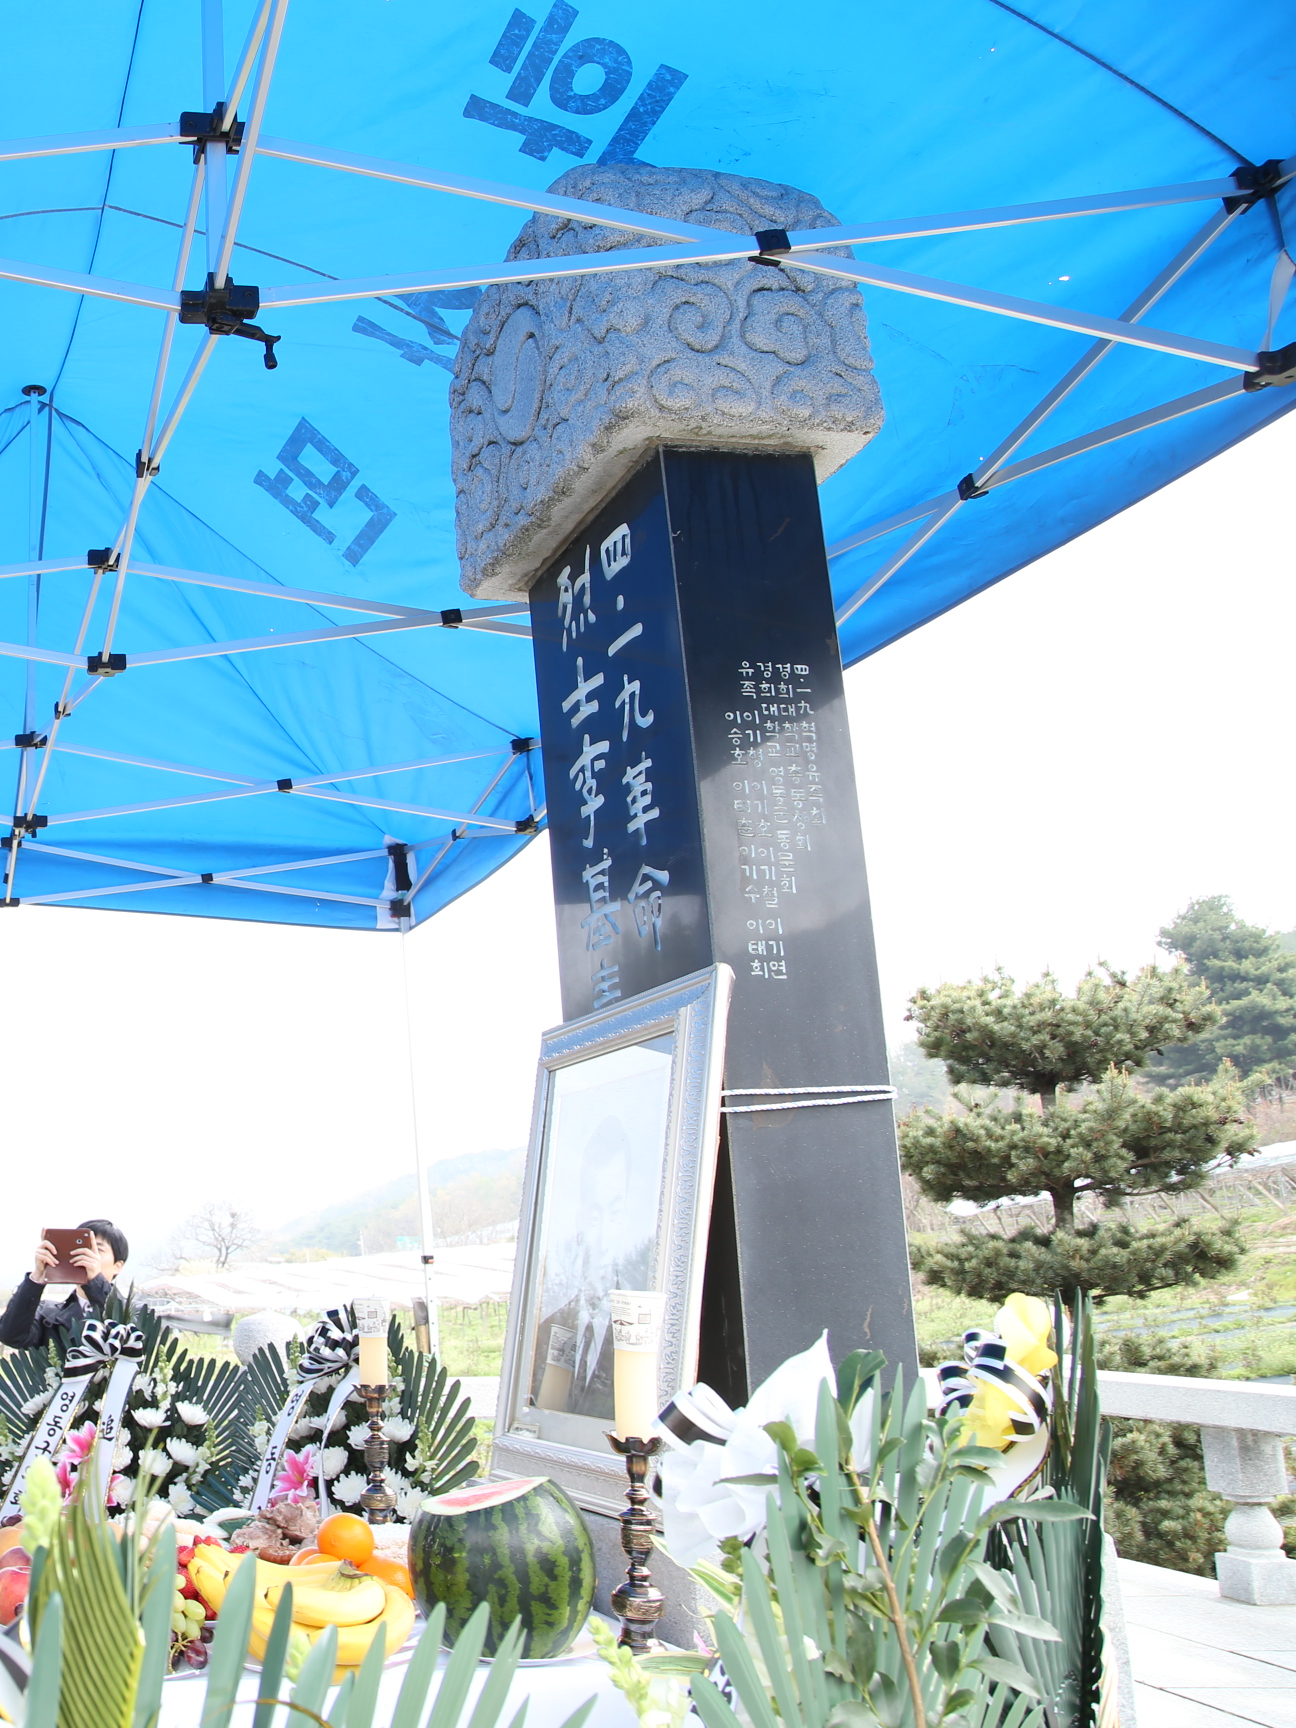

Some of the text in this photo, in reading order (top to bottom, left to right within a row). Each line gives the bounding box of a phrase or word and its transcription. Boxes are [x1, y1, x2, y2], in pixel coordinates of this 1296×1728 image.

[724, 710, 748, 766] 이승호
[746, 917, 769, 979] 이태희
[737, 660, 757, 699] 유족
[765, 917, 788, 980] 이기연
